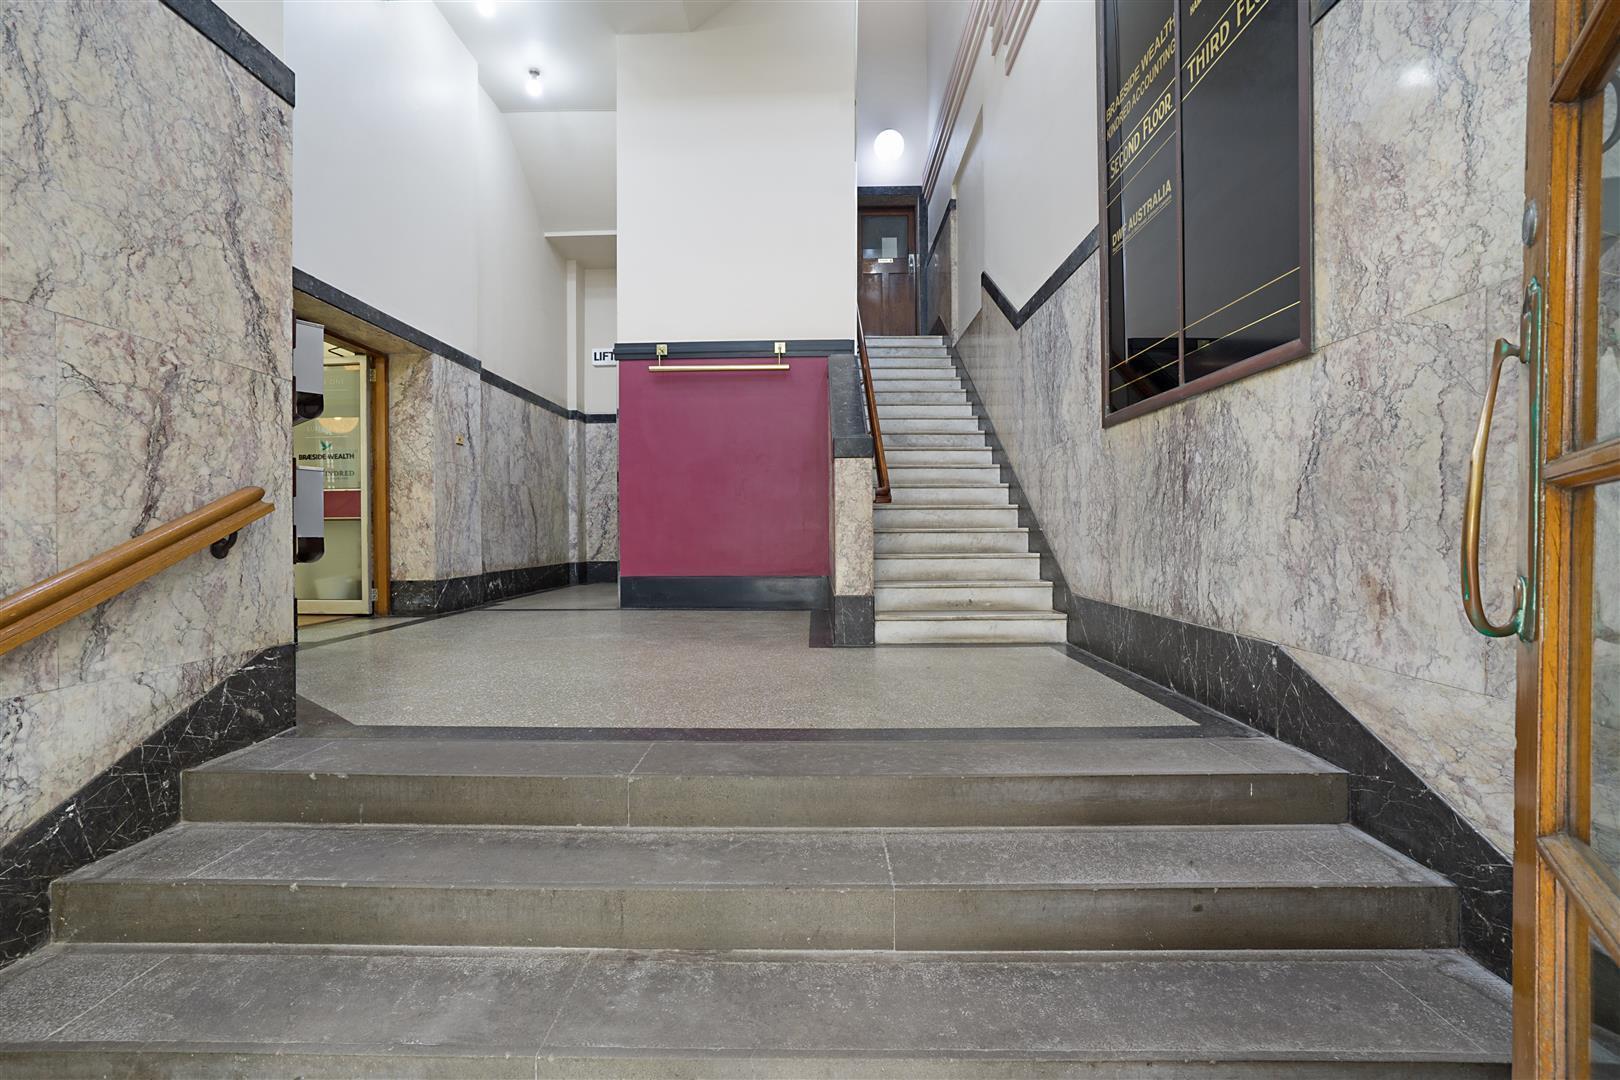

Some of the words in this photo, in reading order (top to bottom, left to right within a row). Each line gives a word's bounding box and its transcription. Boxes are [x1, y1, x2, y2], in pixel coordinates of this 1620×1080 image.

[1106, 63, 1140, 122] BRAESIDE
[1141, 15, 1176, 72] WEALTH
[1187, 20, 1230, 83] THIRD
[1236, 0, 1262, 28] FL
[1106, 99, 1132, 141] KINDRED
[1131, 38, 1176, 107] ACCOUNTING
[1110, 132, 1140, 180] SECOND
[1128, 179, 1173, 232] AUSTRALIA
[594, 351, 614, 361] LIFT
